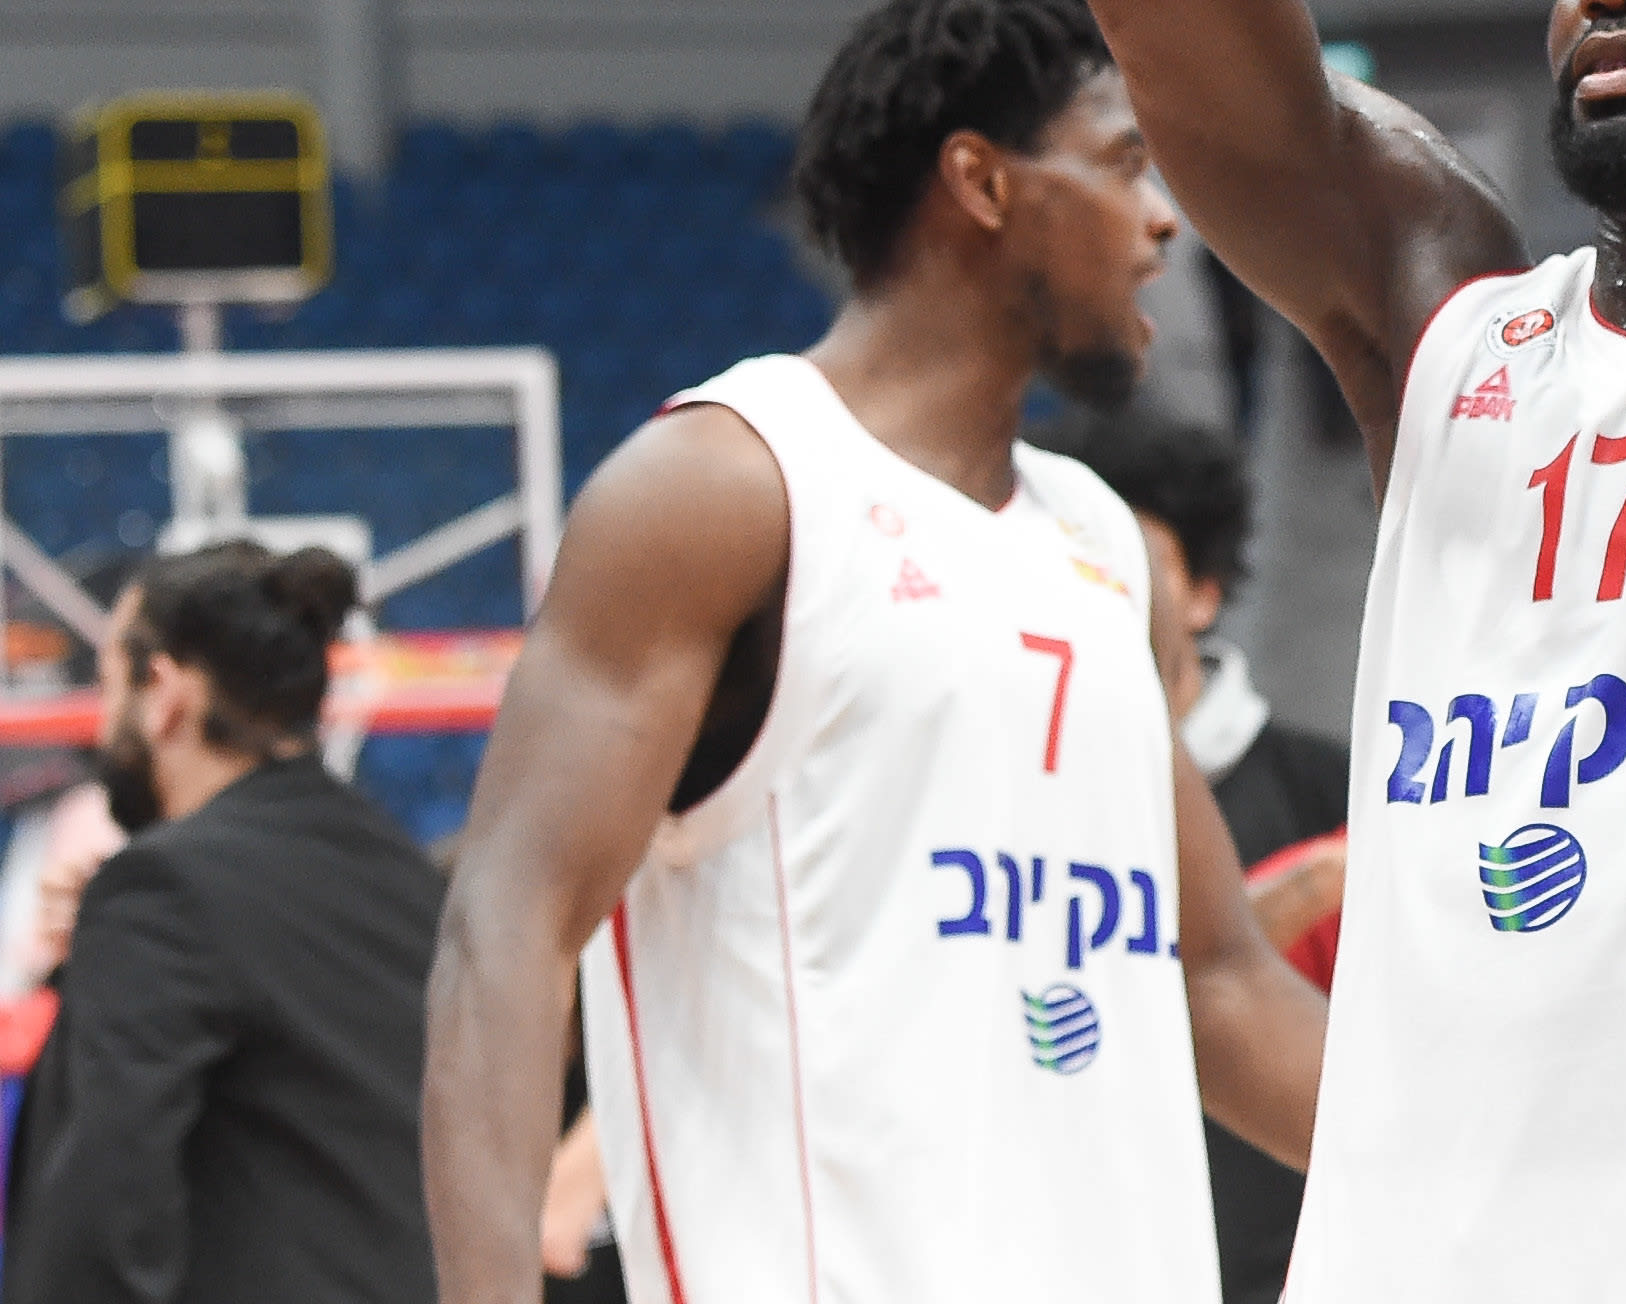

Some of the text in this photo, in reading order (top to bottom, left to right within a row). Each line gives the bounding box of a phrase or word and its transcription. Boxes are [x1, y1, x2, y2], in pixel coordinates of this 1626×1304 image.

[1019, 631, 1074, 774] 7
[1386, 693, 1539, 805] יהב
[1066, 862, 1179, 970] נק
